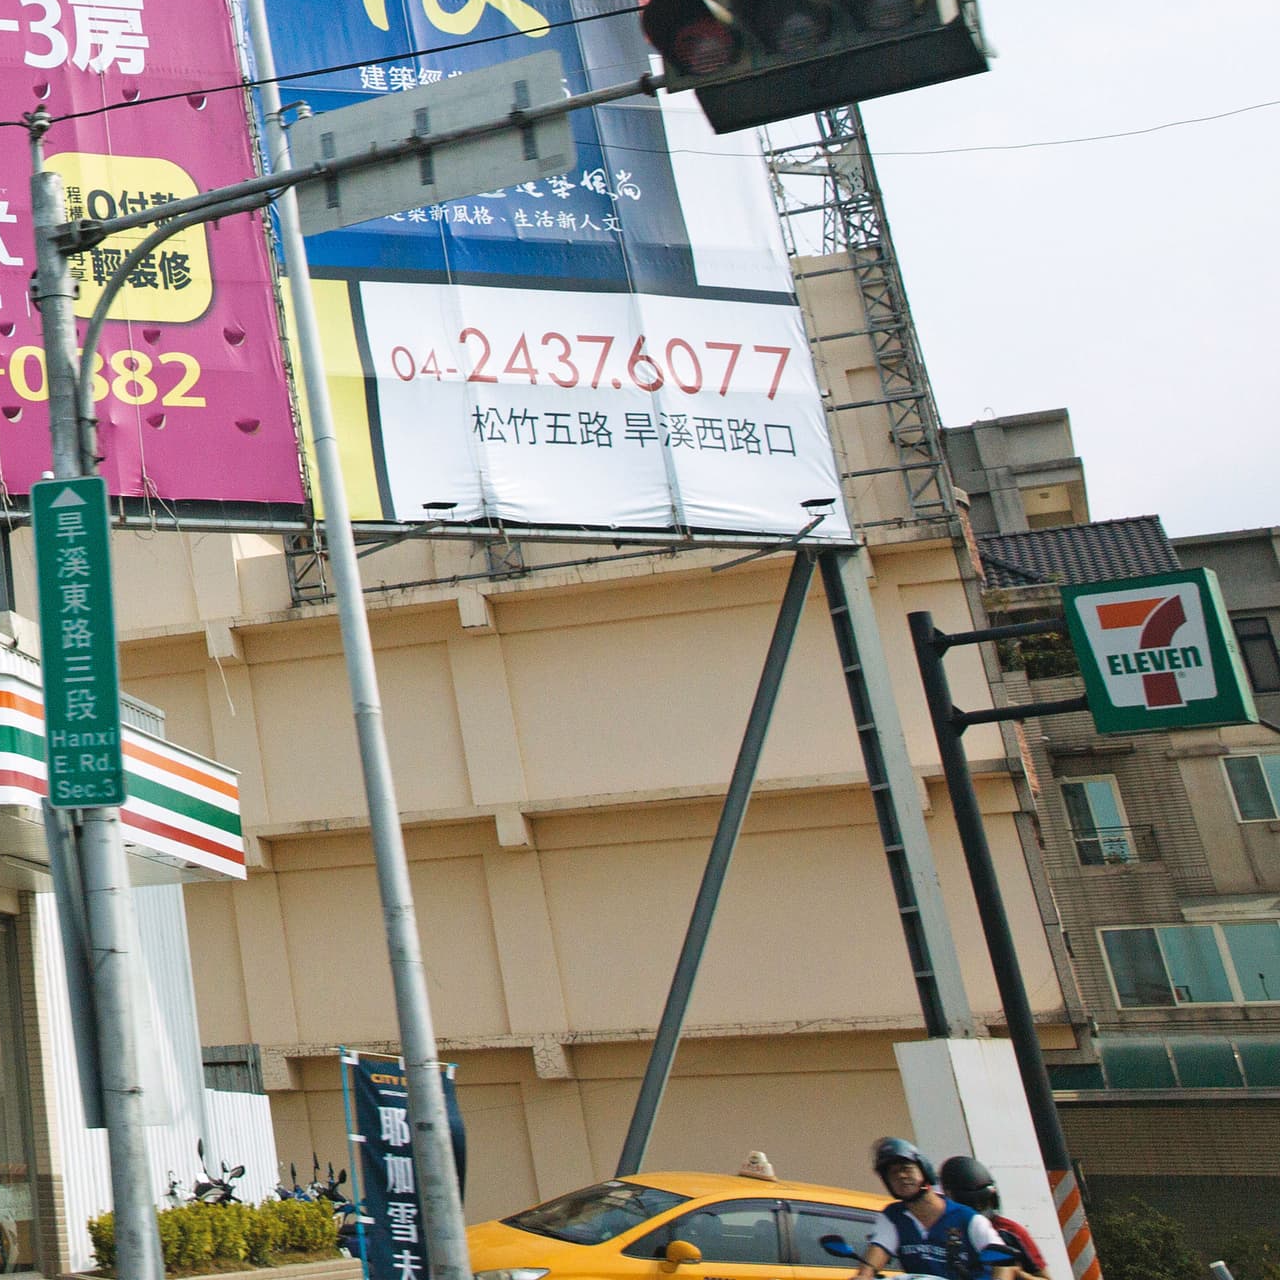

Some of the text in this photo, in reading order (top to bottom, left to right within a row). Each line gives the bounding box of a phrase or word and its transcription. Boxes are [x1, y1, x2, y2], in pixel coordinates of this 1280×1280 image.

[472, 405, 798, 458] 松竹五路 旱溪西路口
[55, 511, 98, 721] 旱溪東路三段
[51, 729, 116, 749] Hanxi
[54, 753, 116, 774] E. Rd.
